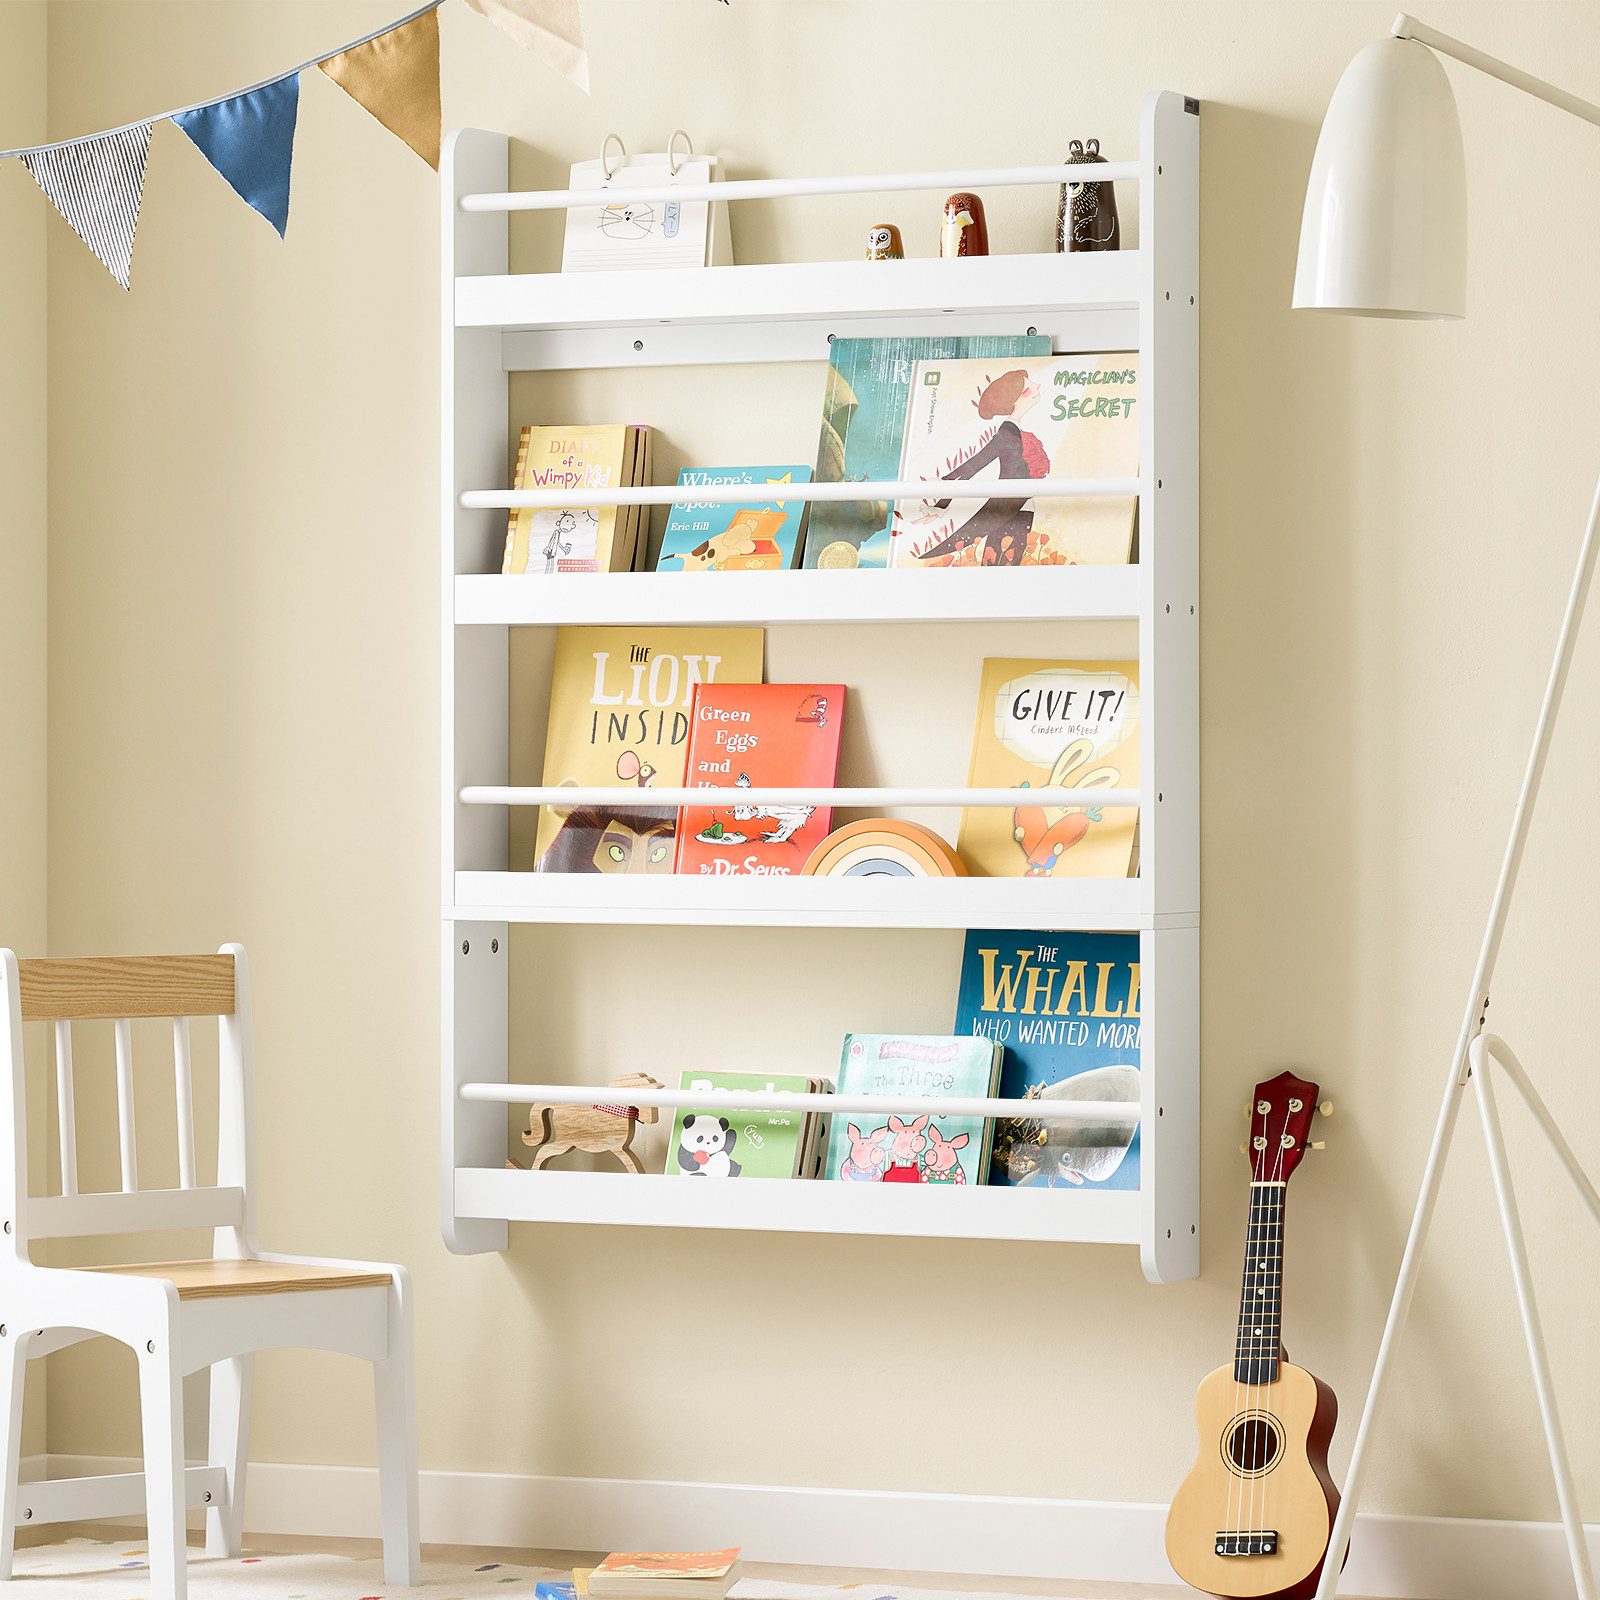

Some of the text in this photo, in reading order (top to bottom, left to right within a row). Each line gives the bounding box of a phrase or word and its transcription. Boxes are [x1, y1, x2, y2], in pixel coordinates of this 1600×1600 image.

[1053, 368, 1137, 387] MAGICIAN'S
[1050, 394, 1137, 421] SECRET
[562, 455, 574, 467] of
[532, 464, 611, 489] Wimpy Kid
[682, 471, 753, 486] Where's
[670, 521, 710, 531] Eric Hill
[630, 644, 652, 663] THE
[700, 705, 751, 723] Green
[1012, 688, 1125, 722] GIVE IT!
[591, 709, 689, 745] INSID
[1030, 724, 1064, 735] Cinders
[714, 729, 759, 753] Eggs
[697, 758, 731, 774] and
[699, 863, 714, 875] By
[743, 855, 791, 876] Seuss
[1037, 944, 1059, 963] THE
[973, 1017, 1012, 1042] WHO
[1018, 1019, 1089, 1047] WANTED
[874, 1065, 955, 1091] The Three
